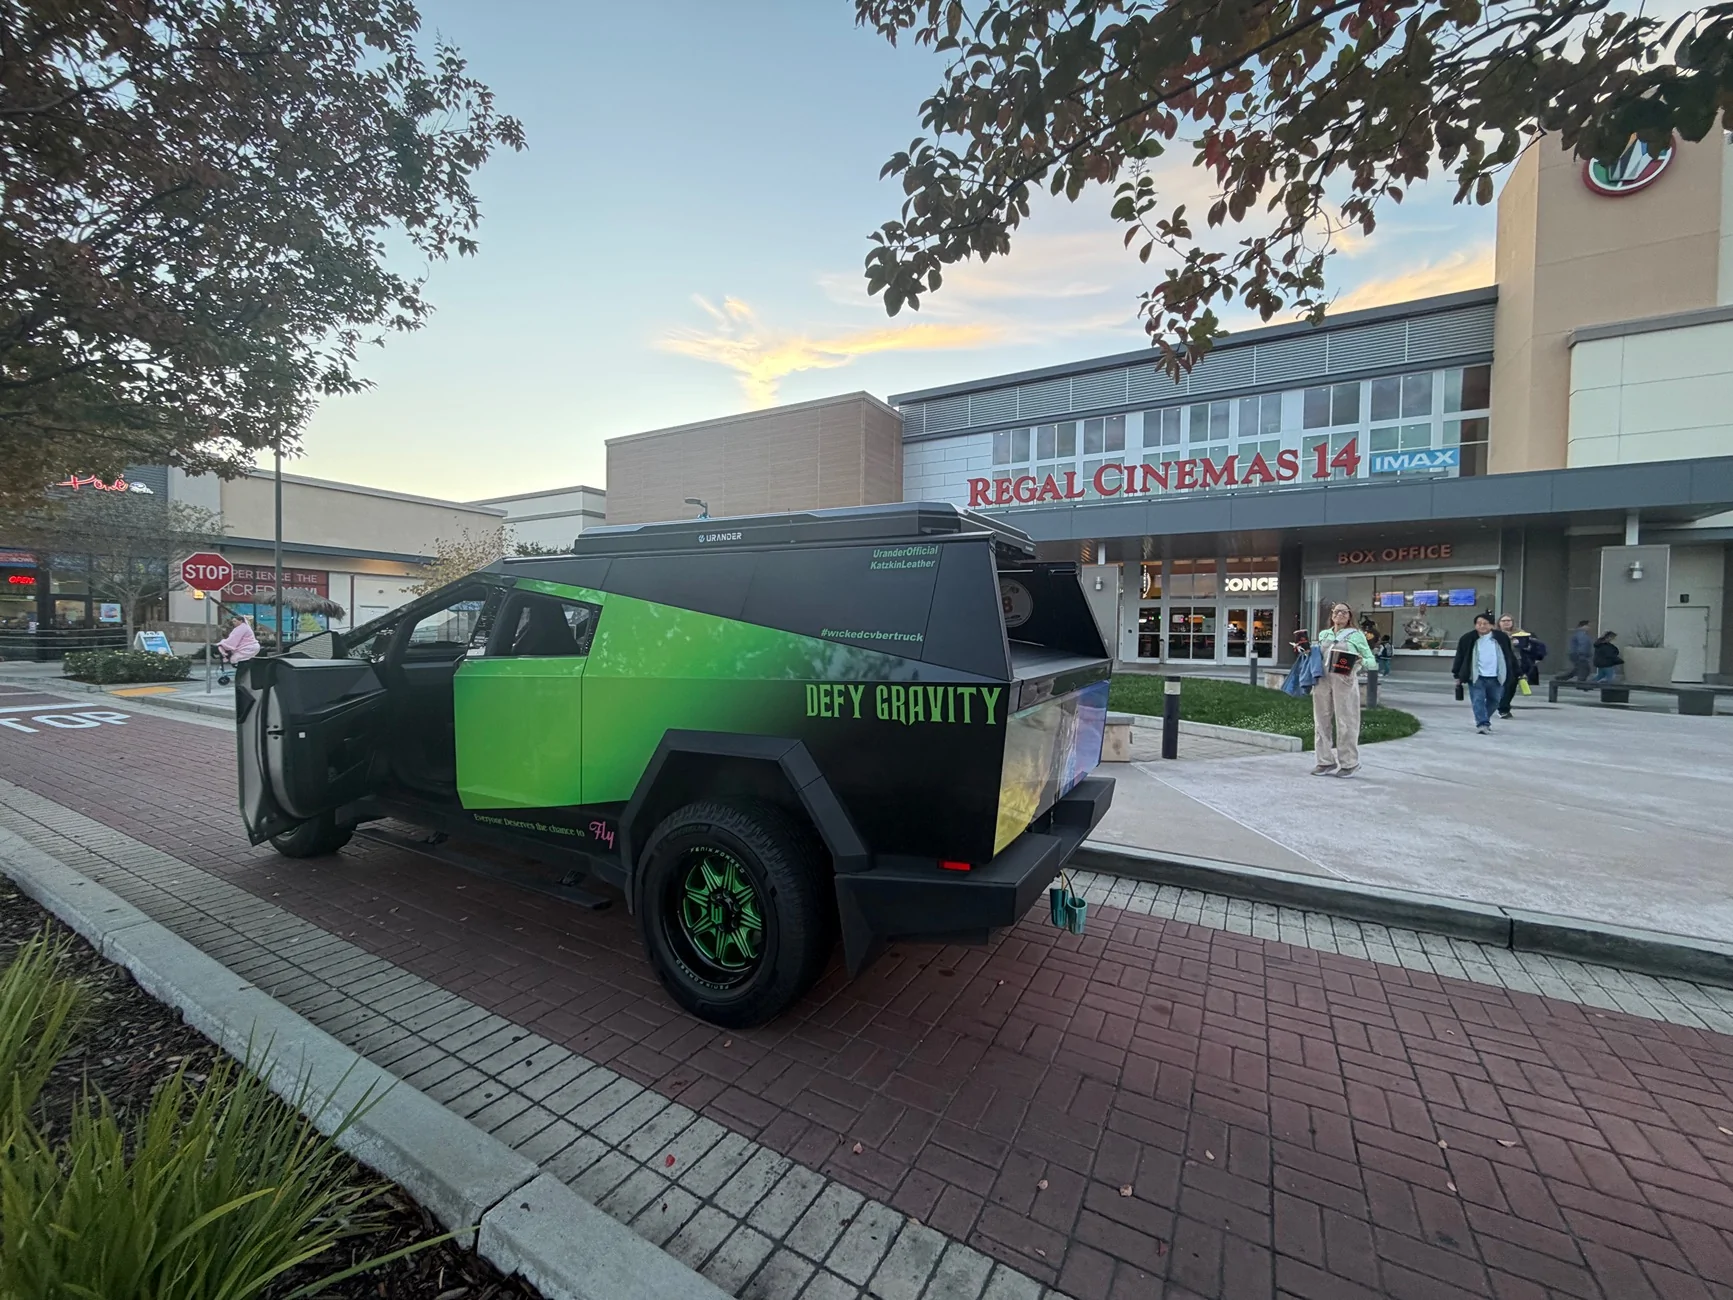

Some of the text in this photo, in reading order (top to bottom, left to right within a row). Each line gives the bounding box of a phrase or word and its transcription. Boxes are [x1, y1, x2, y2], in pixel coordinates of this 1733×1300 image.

[1375, 449, 1457, 471] IMAX
[967, 437, 1362, 508] REGAL CINEMAS 14
[706, 532, 743, 543] URANDER
[872, 545, 939, 558] UranderOfficial
[1338, 544, 1453, 565] BOX OFFICE
[185, 564, 230, 580] STOP
[870, 559, 936, 571] KatzkinLeather
[8, 575, 36, 585] OPEN
[296, 573, 318, 583] THE
[1225, 577, 1279, 592] ONCE
[805, 683, 1003, 726] DEFY GRAVITY
[0, 711, 132, 733] TOP
[473, 813, 615, 850] Everyone Deserves the chance to Fly
